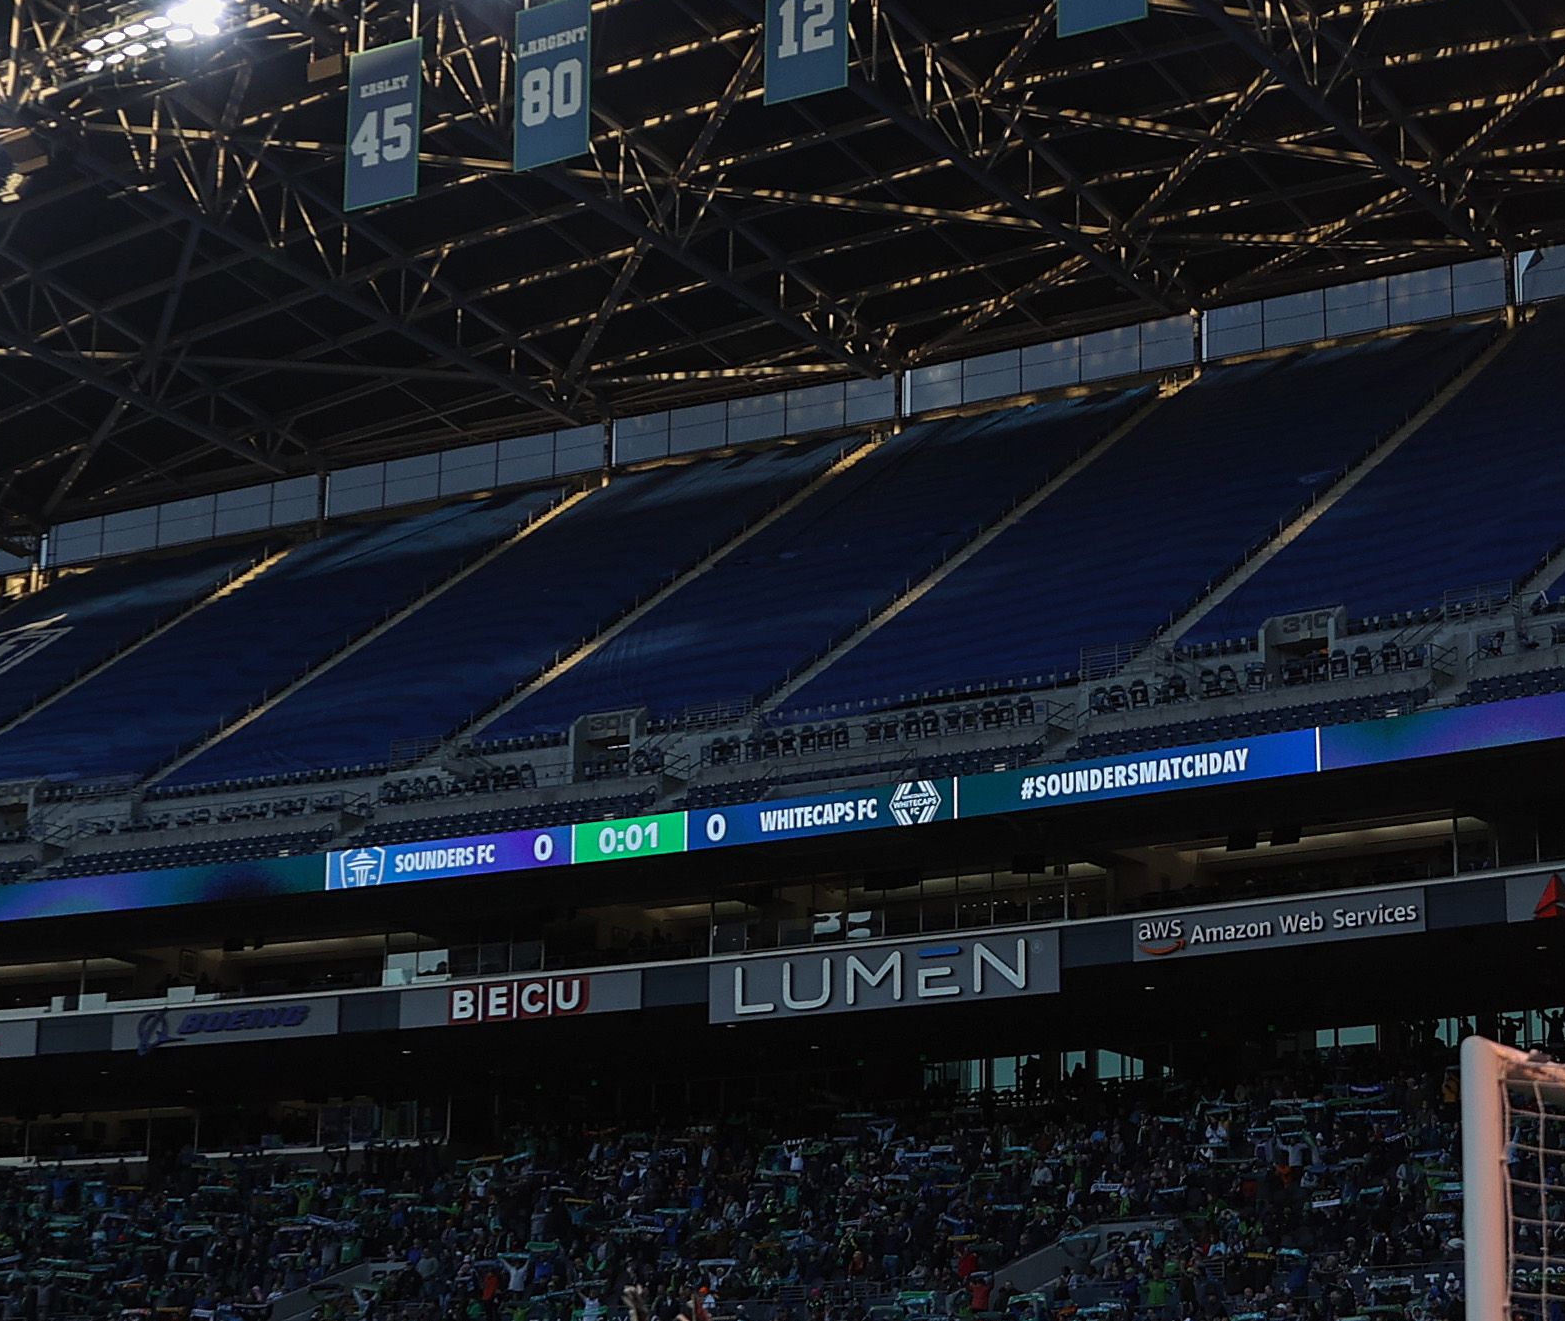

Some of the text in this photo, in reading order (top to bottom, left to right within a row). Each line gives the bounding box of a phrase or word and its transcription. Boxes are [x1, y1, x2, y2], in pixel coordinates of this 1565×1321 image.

[517, 25, 587, 57] LARGENT
[359, 75, 410, 99] EASLEY
[521, 58, 583, 127] 80
[351, 103, 413, 167] 45
[1021, 748, 1249, 800] #SOUNDERSMATCHDAY
[706, 798, 878, 842] 0 WHITECAPS FC
[893, 797, 937, 809] WHITECAPS
[394, 833, 554, 873] SOUNDERS FC 0
[598, 822, 659, 854] 0:01
[1138, 903, 1417, 945] aws Amazon Web Services
[735, 938, 1027, 1016] LUMEN
[179, 1004, 310, 1035] BOEING
